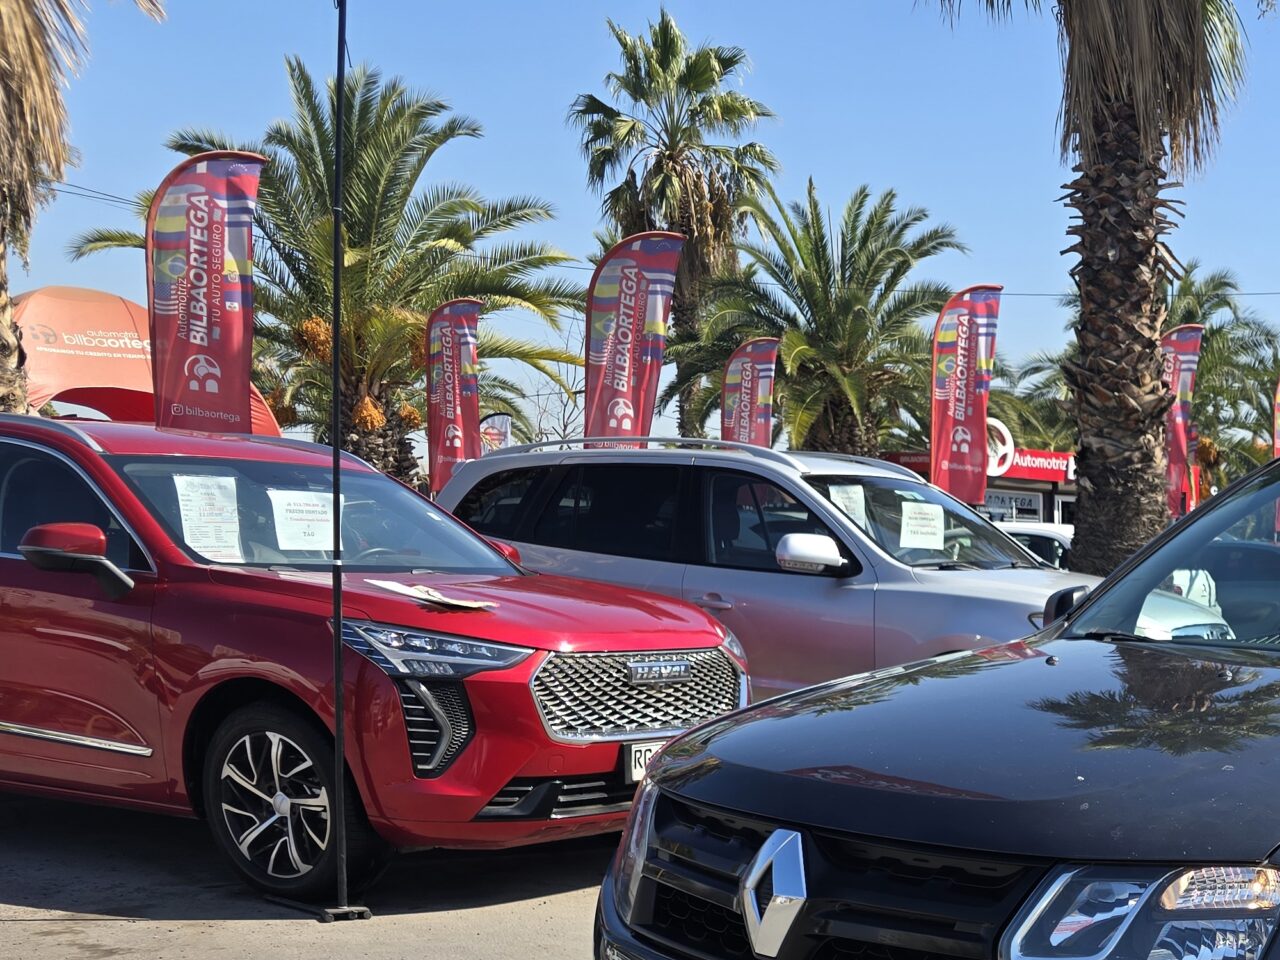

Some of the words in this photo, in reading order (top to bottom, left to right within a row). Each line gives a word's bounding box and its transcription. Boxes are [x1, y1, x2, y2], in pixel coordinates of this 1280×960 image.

[212, 224, 223, 270] SEGURO
[189, 194, 210, 347] BILBAORTEGA
[211, 273, 222, 305] AUTO
[177, 277, 188, 340] Automotriz
[211, 310, 221, 323] TU
[636, 292, 647, 331] SEGURO
[62, 332, 151, 351] bilbaorteg
[87, 330, 139, 339] automotriz
[613, 267, 639, 393] BILBAORTEGA
[633, 332, 642, 361] AUTO
[441, 326, 455, 420] BILBAORTEGA
[603, 333, 616, 386] Automotriz
[955, 314, 971, 421] BILBAORTEGA
[185, 405, 241, 422] bilbaortega
[740, 362, 753, 443] BILBAORTEGA
[1013, 452, 1068, 471] Automotriz
[636, 665, 687, 679] HAVAL
